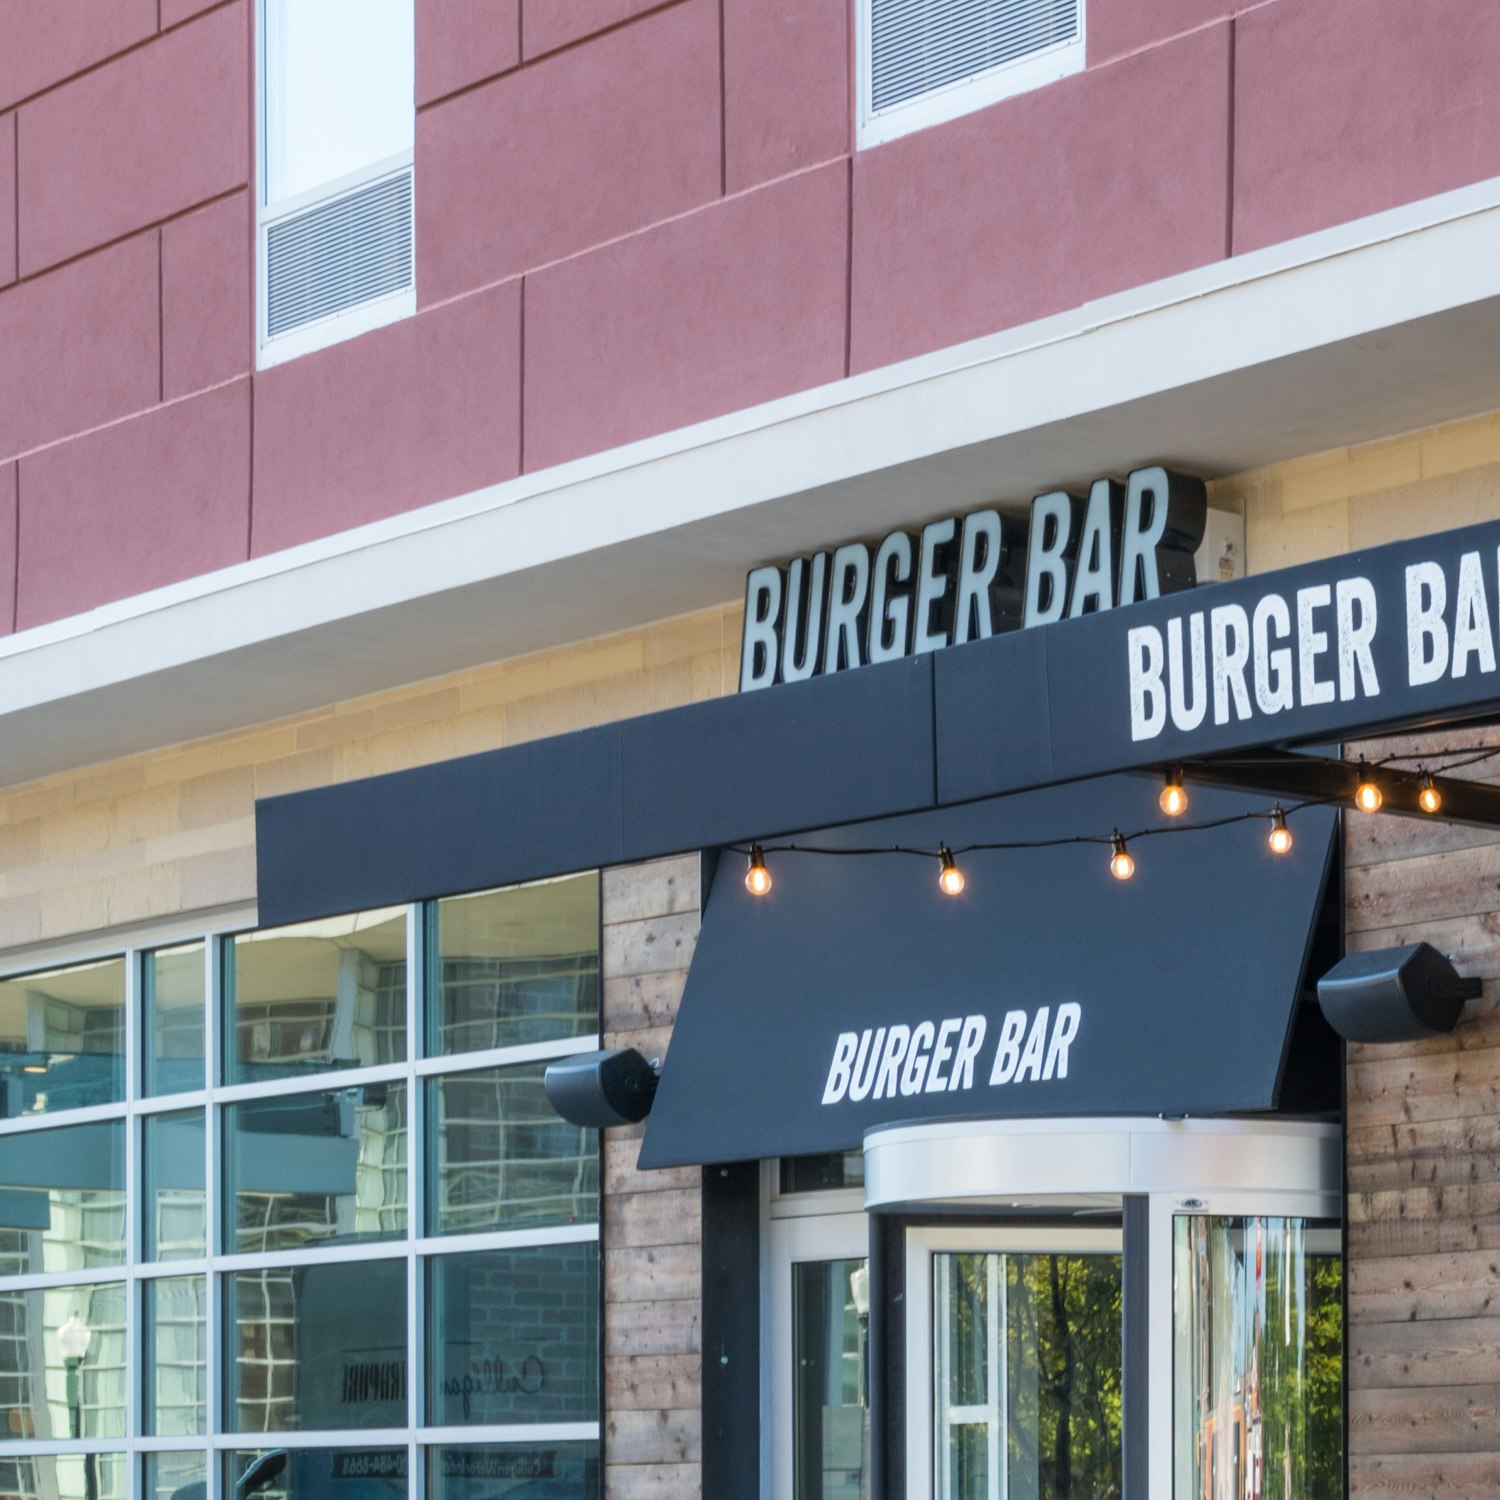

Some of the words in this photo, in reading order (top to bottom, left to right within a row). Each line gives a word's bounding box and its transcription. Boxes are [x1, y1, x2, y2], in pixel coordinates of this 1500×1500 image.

[739, 509, 1002, 693] BURGER
[1023, 466, 1170, 629] BAR
[1127, 577, 1381, 742] BURGER
[822, 1014, 984, 1106] BURGER
[989, 1002, 1082, 1086] BAR
